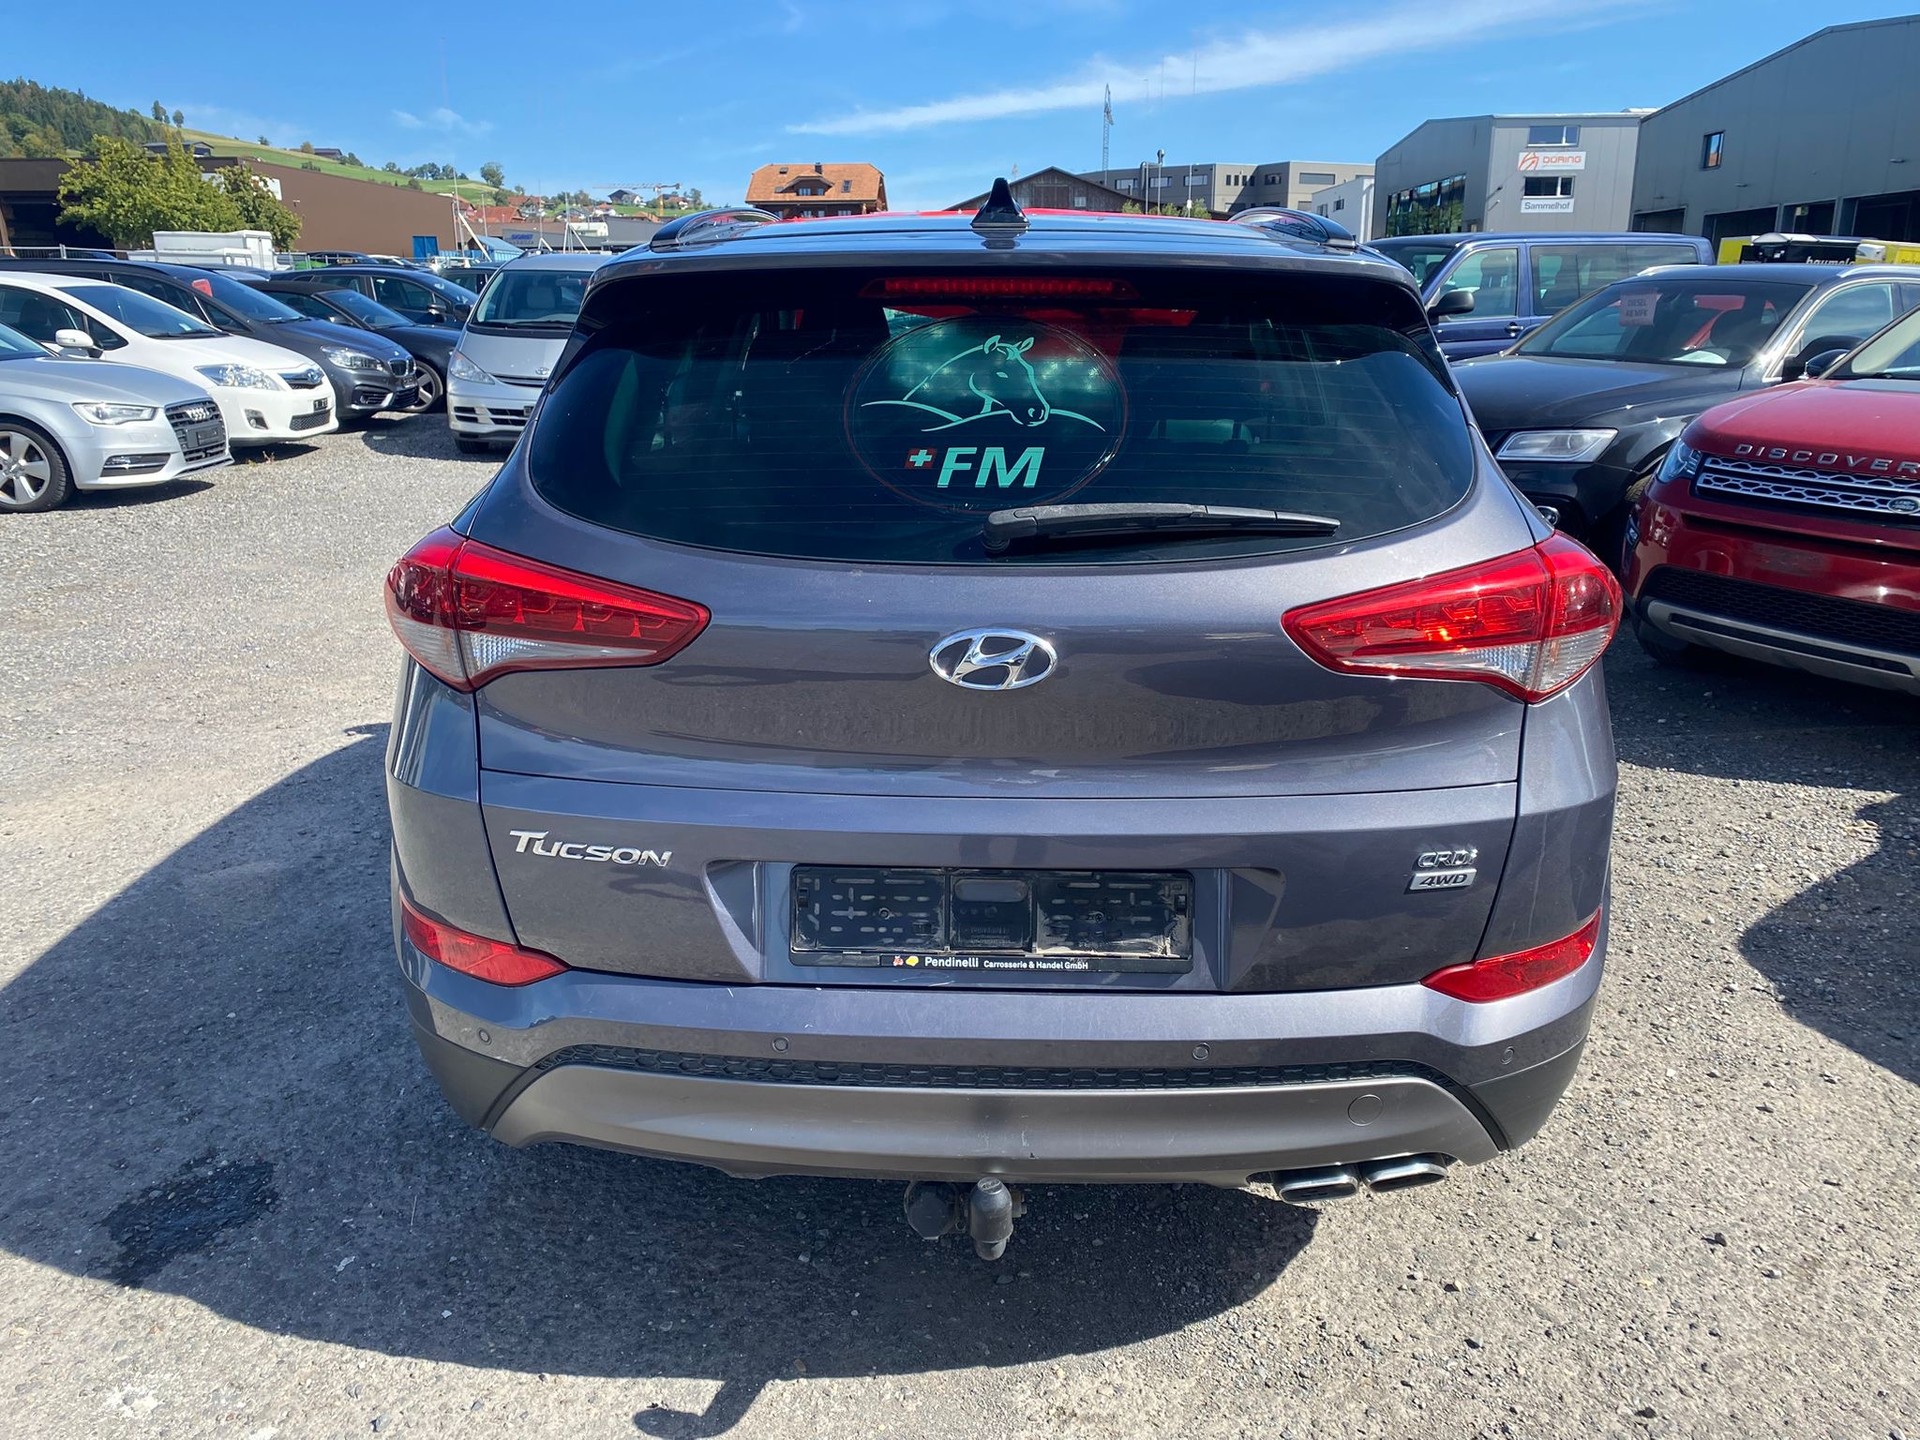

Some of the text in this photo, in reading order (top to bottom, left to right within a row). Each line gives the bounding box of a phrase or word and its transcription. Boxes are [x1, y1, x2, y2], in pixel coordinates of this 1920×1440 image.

[1524, 202, 1570, 210] Sammelhof
[936, 447, 1046, 488] FM
[1734, 443, 1920, 474] DISCOVER
[509, 829, 673, 867] TUCSON
[1418, 873, 1468, 887] 4WD
[924, 956, 1089, 970] Pendinelli Carrosserie & Handel GmbH
